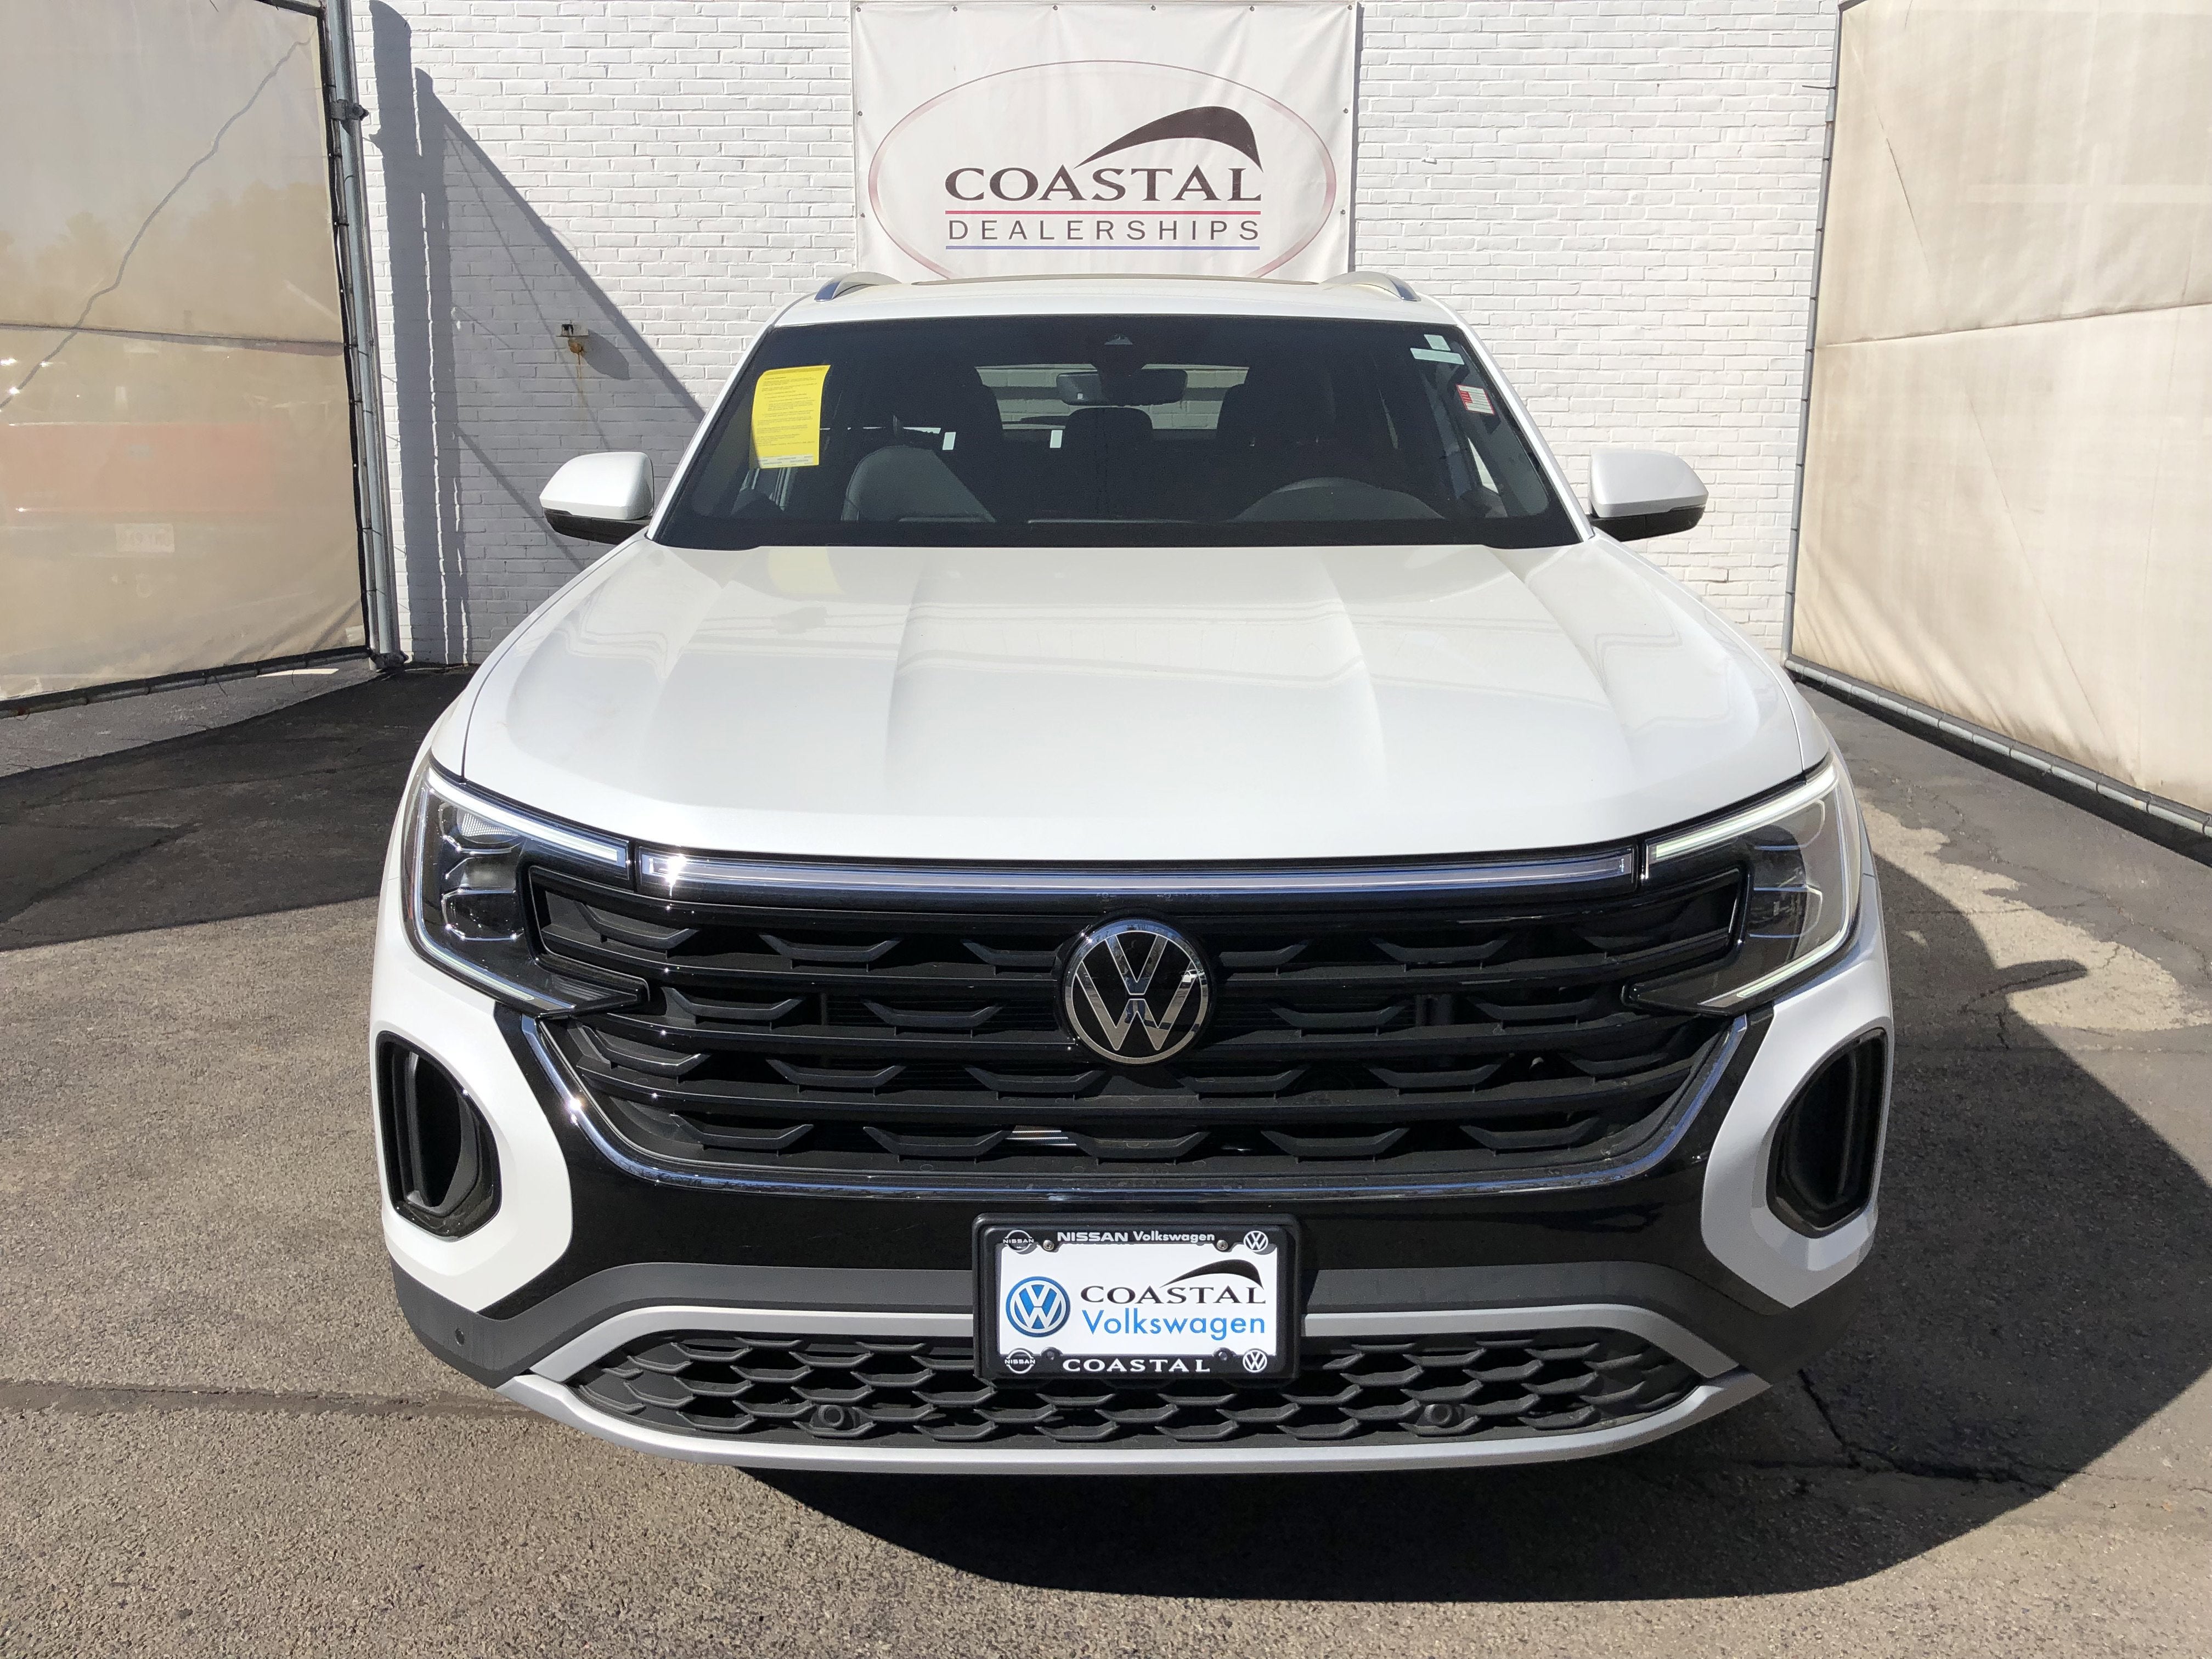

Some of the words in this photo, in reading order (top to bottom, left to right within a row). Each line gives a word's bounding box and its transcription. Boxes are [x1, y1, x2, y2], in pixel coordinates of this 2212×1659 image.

[945, 164, 1262, 201] COASTAL
[949, 219, 1259, 240] DEALERSHIPS
[1057, 1232, 1128, 1242] NISSAN
[1132, 1230, 1215, 1244] Volkswagen
[1081, 1285, 1266, 1305] COASTAL
[1081, 1307, 1265, 1341] Volkswagen
[1062, 1358, 1210, 1373] COASTAL
